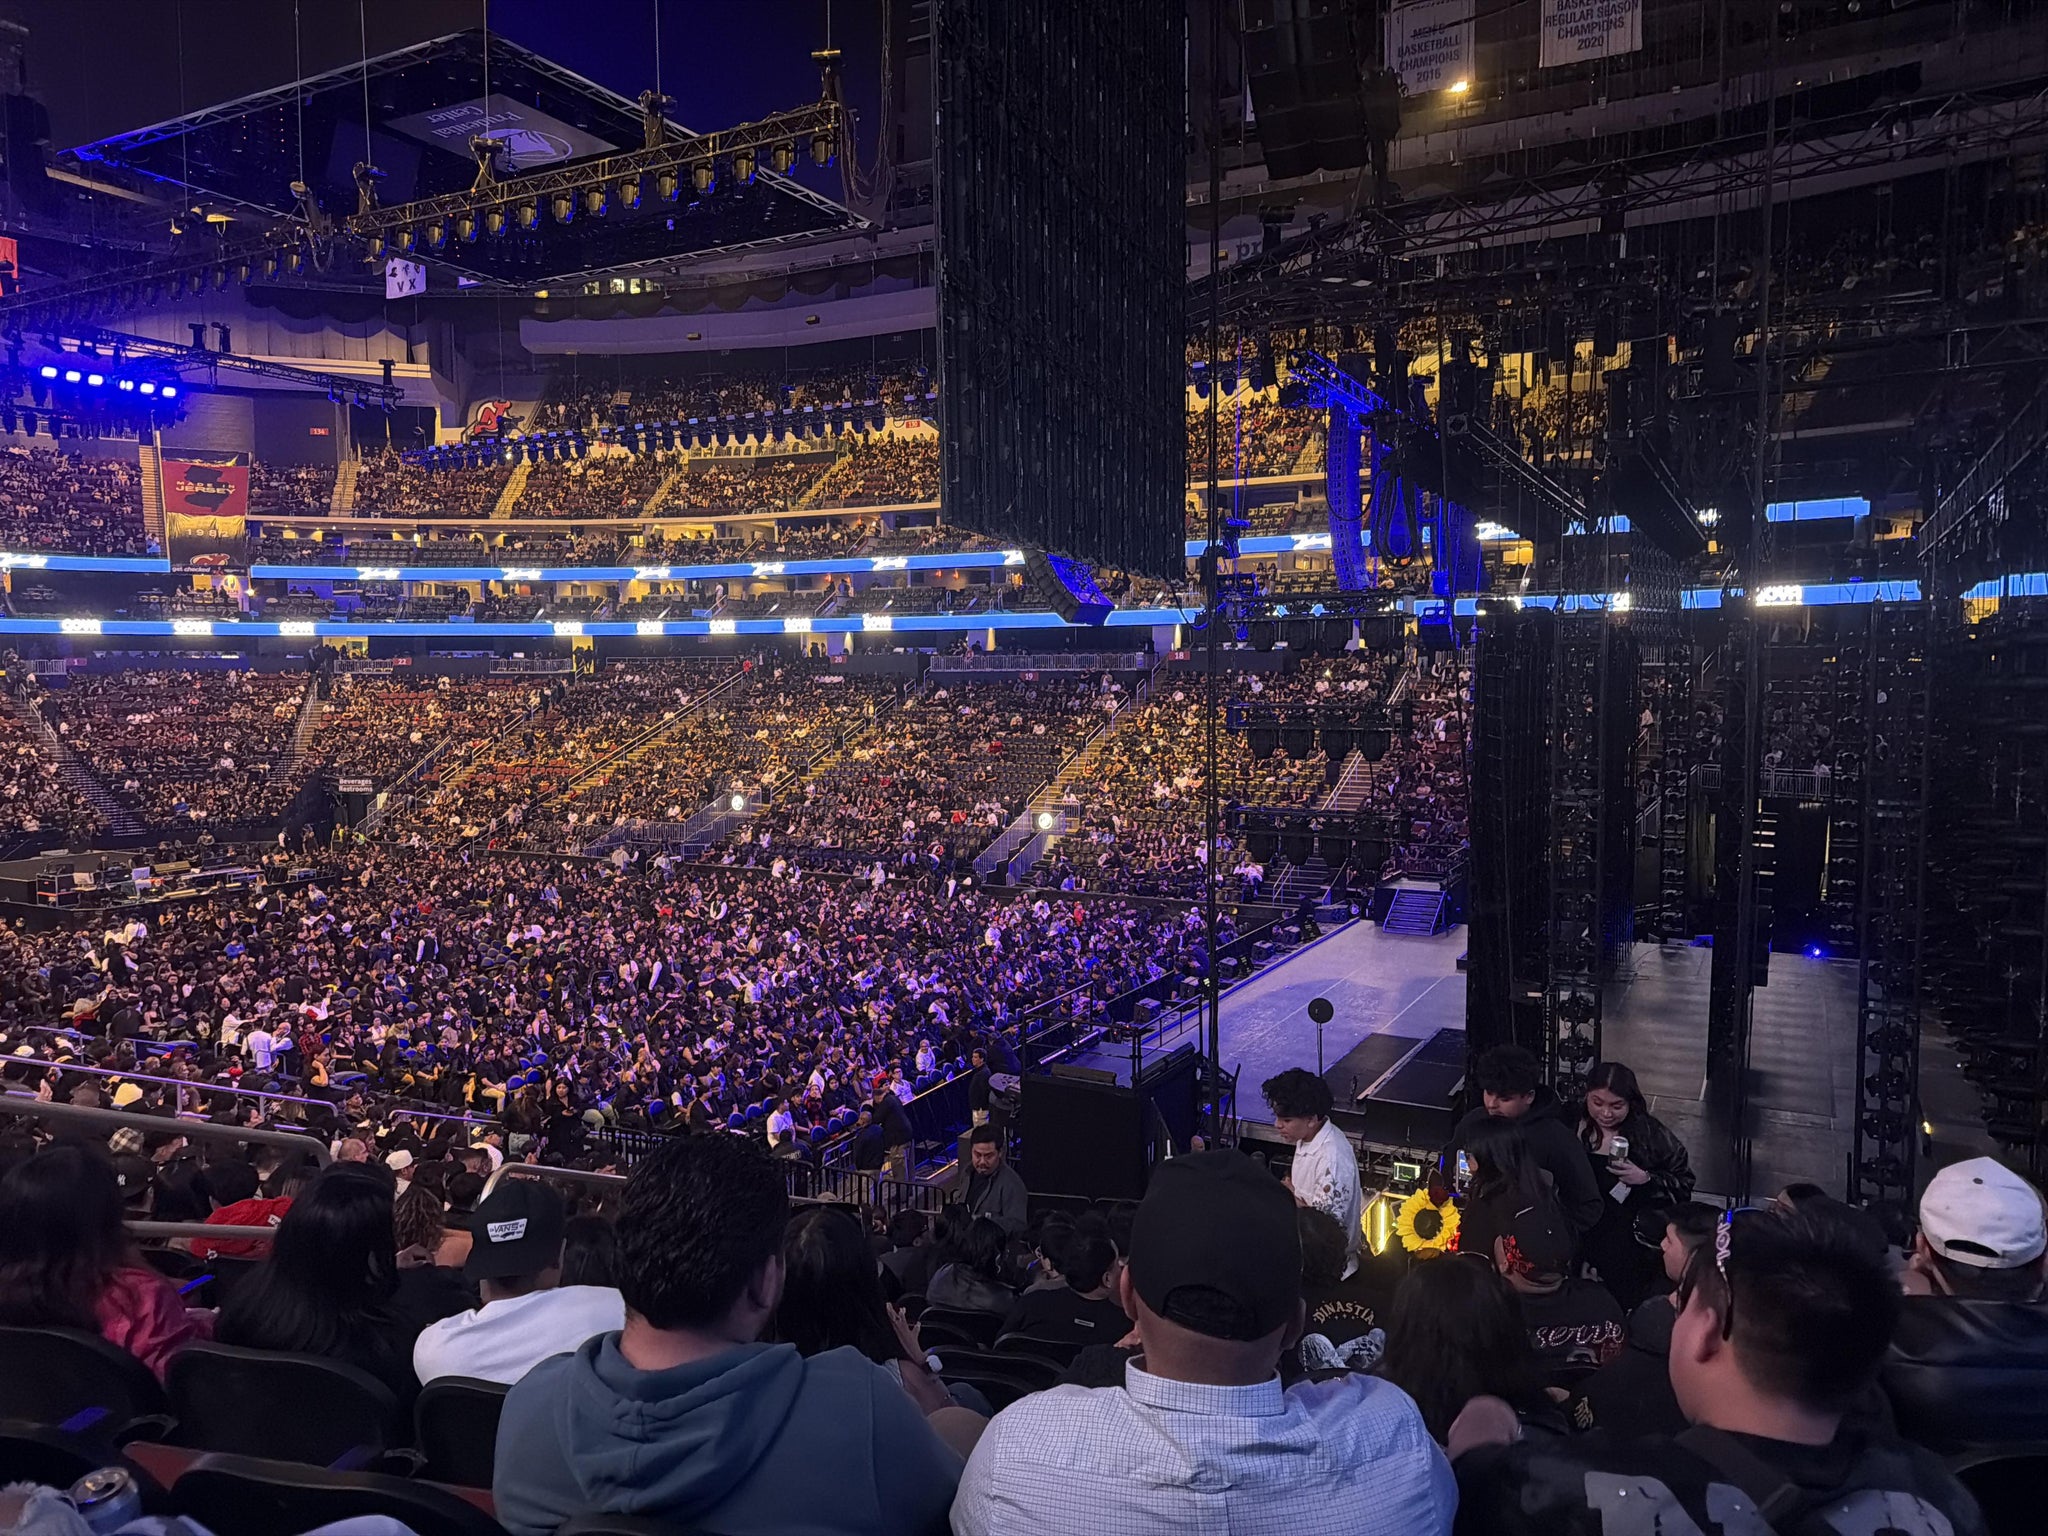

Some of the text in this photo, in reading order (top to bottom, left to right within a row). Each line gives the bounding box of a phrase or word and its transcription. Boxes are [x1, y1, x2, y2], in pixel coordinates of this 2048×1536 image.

[1545, 9, 1593, 27] REGULAR
[1558, 16, 1625, 40] CHAMPIONS
[1398, 35, 1461, 58] BASKETBALL
[1577, 35, 1605, 51] 2020
[1398, 49, 1460, 72] CHAMPIONS
[175, 486, 236, 494] JERSEY
[1174, 651, 1185, 660] 18
[1025, 672, 1033, 680] 19
[494, 1221, 520, 1234] VANS
